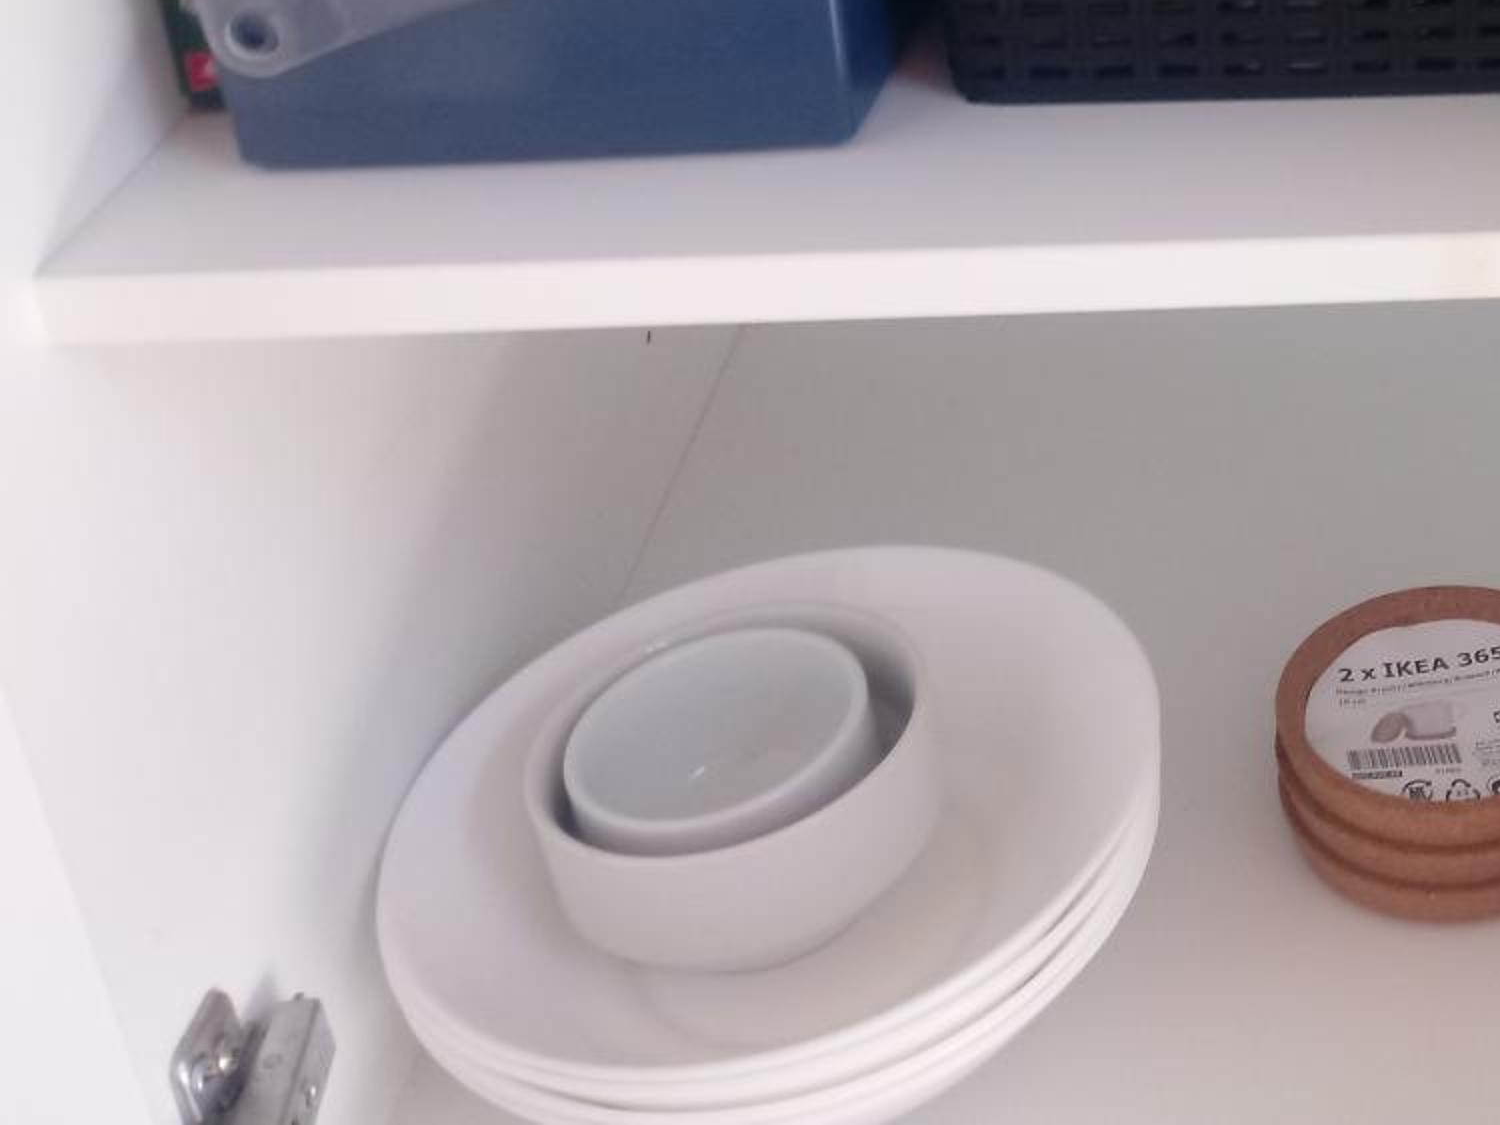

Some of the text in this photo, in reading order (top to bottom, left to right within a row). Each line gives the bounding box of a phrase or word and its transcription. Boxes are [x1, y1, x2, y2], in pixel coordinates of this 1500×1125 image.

[1339, 668, 1354, 682] 2
[1361, 668, 1376, 680] x
[1383, 656, 1450, 679] IKEA
